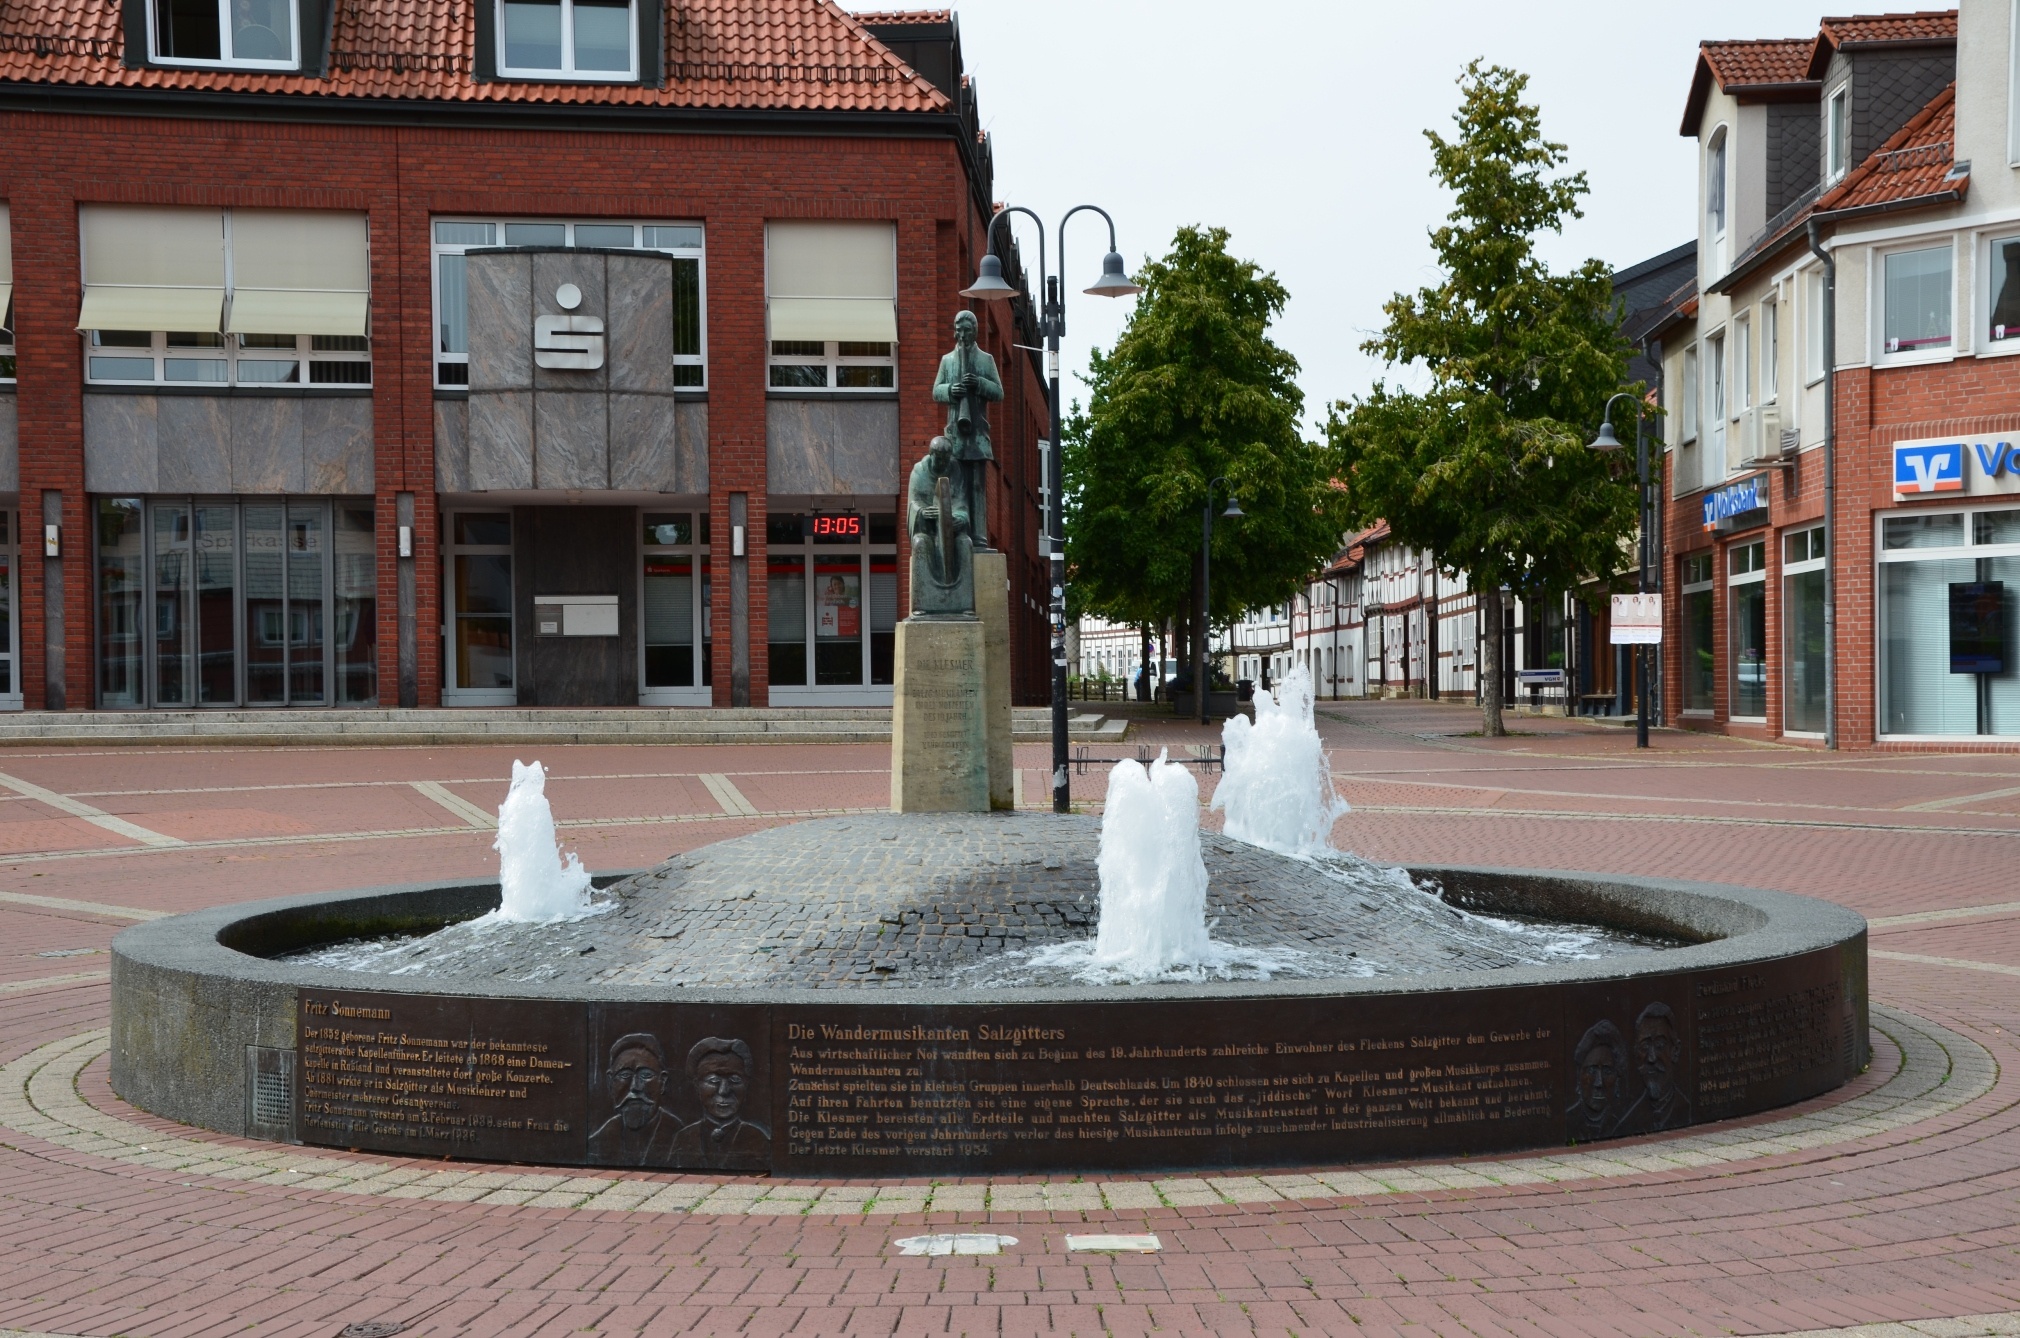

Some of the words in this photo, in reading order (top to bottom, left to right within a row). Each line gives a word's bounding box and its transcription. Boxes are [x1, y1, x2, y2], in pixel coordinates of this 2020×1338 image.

[1717, 478, 1758, 518] Volksbank
[814, 517, 859, 534] 13:05
[305, 999, 329, 1015] Fritz
[332, 1000, 391, 1019] Sonnemann
[305, 1027, 318, 1039] Der
[320, 1028, 340, 1038] 1852
[341, 1030, 375, 1044] geborene
[378, 1033, 397, 1044] Fritz
[400, 1034, 448, 1048] Sonnemann
[451, 1041, 468, 1049] war
[472, 1038, 486, 1050] der
[489, 1038, 548, 1053] bekannteste
[788, 1024, 815, 1040] Die
[820, 1024, 970, 1041] Wandermusikanten
[978, 1024, 1065, 1046] Salzgitters
[790, 1046, 813, 1059] Aus
[818, 1048, 912, 1060] wirtschaftlicher
[917, 1048, 937, 1060] Not
[943, 1048, 990, 1060] wandten
[995, 1048, 1018, 1060] sich
[1039, 1048, 1079, 1063] Beginn
[1085, 1048, 1106, 1059] des
[1212, 1043, 1269, 1056] zahlreiche
[1275, 1040, 1334, 1055] Einwohner
[1337, 1040, 1356, 1052] des
[1359, 1038, 1405, 1051] Fleckens
[1410, 1035, 1461, 1050] Salzgitter
[1467, 1033, 1486, 1045] dem
[1490, 1030, 1531, 1043] Gewerbe
[1536, 1027, 1551, 1039] der
[435, 1051, 464, 1064] leitete
[467, 1053, 478, 1064] ab
[480, 1054, 505, 1066] 1868
[507, 1057, 527, 1067] eine
[789, 1063, 902, 1076] Wandermusikanten
[375, 1063, 390, 1075] und
[393, 1066, 451, 1079] veranstaltete
[453, 1067, 473, 1080] dort
[789, 1078, 840, 1091] Zunächst
[843, 1080, 887, 1094] spielten
[890, 1081, 908, 1091] sie
[911, 1081, 922, 1091] in
[925, 1080, 965, 1091] kleinen
[970, 1080, 1018, 1095] Gruppen
[1022, 1080, 1076, 1091] innerhalb
[1160, 1077, 1180, 1089] Um
[1184, 1076, 1214, 1089] 1840
[1216, 1075, 1270, 1088] schlossen
[1273, 1075, 1289, 1086] sie
[1292, 1073, 1314, 1085] sich
[1318, 1075, 1331, 1084] zu
[1334, 1070, 1380, 1085] Kapellen
[1385, 1068, 1404, 1080] und
[1410, 1066, 1443, 1082] großen
[1445, 1063, 1500, 1077] Musikkorps
[305, 1071, 317, 1083] Ab
[337, 1075, 361, 1087] wirkte
[364, 1080, 373, 1088] er
[374, 1079, 383, 1089] in
[386, 1078, 428, 1095] Salzgitter
[431, 1082, 444, 1094] als
[447, 1082, 506, 1098] Musiklehrer
[509, 1087, 527, 1099] und
[788, 1110, 810, 1122] Die
[816, 1110, 868, 1123] Klesmer
[876, 1112, 933, 1123] bereisten
[941, 1111, 963, 1123] alle
[971, 1111, 1024, 1123] Erdteile
[1031, 1111, 1053, 1123] und
[1060, 1110, 1111, 1123] machten
[1119, 1109, 1182, 1125] Salzgitter
[1188, 1109, 1207, 1120] als
[1215, 1103, 1318, 1119] Musikantenstadt
[1325, 1103, 1336, 1115] in
[1342, 1102, 1360, 1114] der
[1366, 1104, 1403, 1117] ganzen
[1408, 1097, 1433, 1109] Welt
[1440, 1095, 1479, 1108] bekannt
[1485, 1094, 1502, 1104] und
[789, 1095, 812, 1108] Auf
[818, 1096, 849, 1108] ihren
[856, 1096, 903, 1108] Fahrten
[910, 1096, 972, 1109] benutzten
[977, 1097, 996, 1108] sie
[1000, 1097, 1027, 1108] eine
[1034, 1097, 1073, 1111] eigene
[1139, 1094, 1160, 1106] der
[1165, 1093, 1183, 1105] sie
[1189, 1092, 1217, 1104] auch
[1223, 1091, 1244, 1103] das
[1325, 1087, 1353, 1099] Wort
[790, 1127, 824, 1143] Gegen
[828, 1127, 857, 1139] Ende
[862, 1127, 880, 1139] des
[886, 1128, 926, 1144] vorigen
[931, 1127, 1009, 1140] Jahrhunderts
[1015, 1128, 1050, 1139] verlor
[1055, 1127, 1075, 1139] das
[1079, 1127, 1119, 1142] hiesige
[1123, 1125, 1212, 1138] Musikantentum
[1216, 1122, 1253, 1138] infolge
[1256, 1120, 1328, 1133] zunehmender
[1434, 1110, 1485, 1124] allmählich
[1489, 1110, 1500, 1119] an
[788, 1142, 810, 1155] Der
[814, 1142, 848, 1155] letzte
[852, 1142, 900, 1155] Klesmer
[906, 1142, 954, 1155] verstarb
